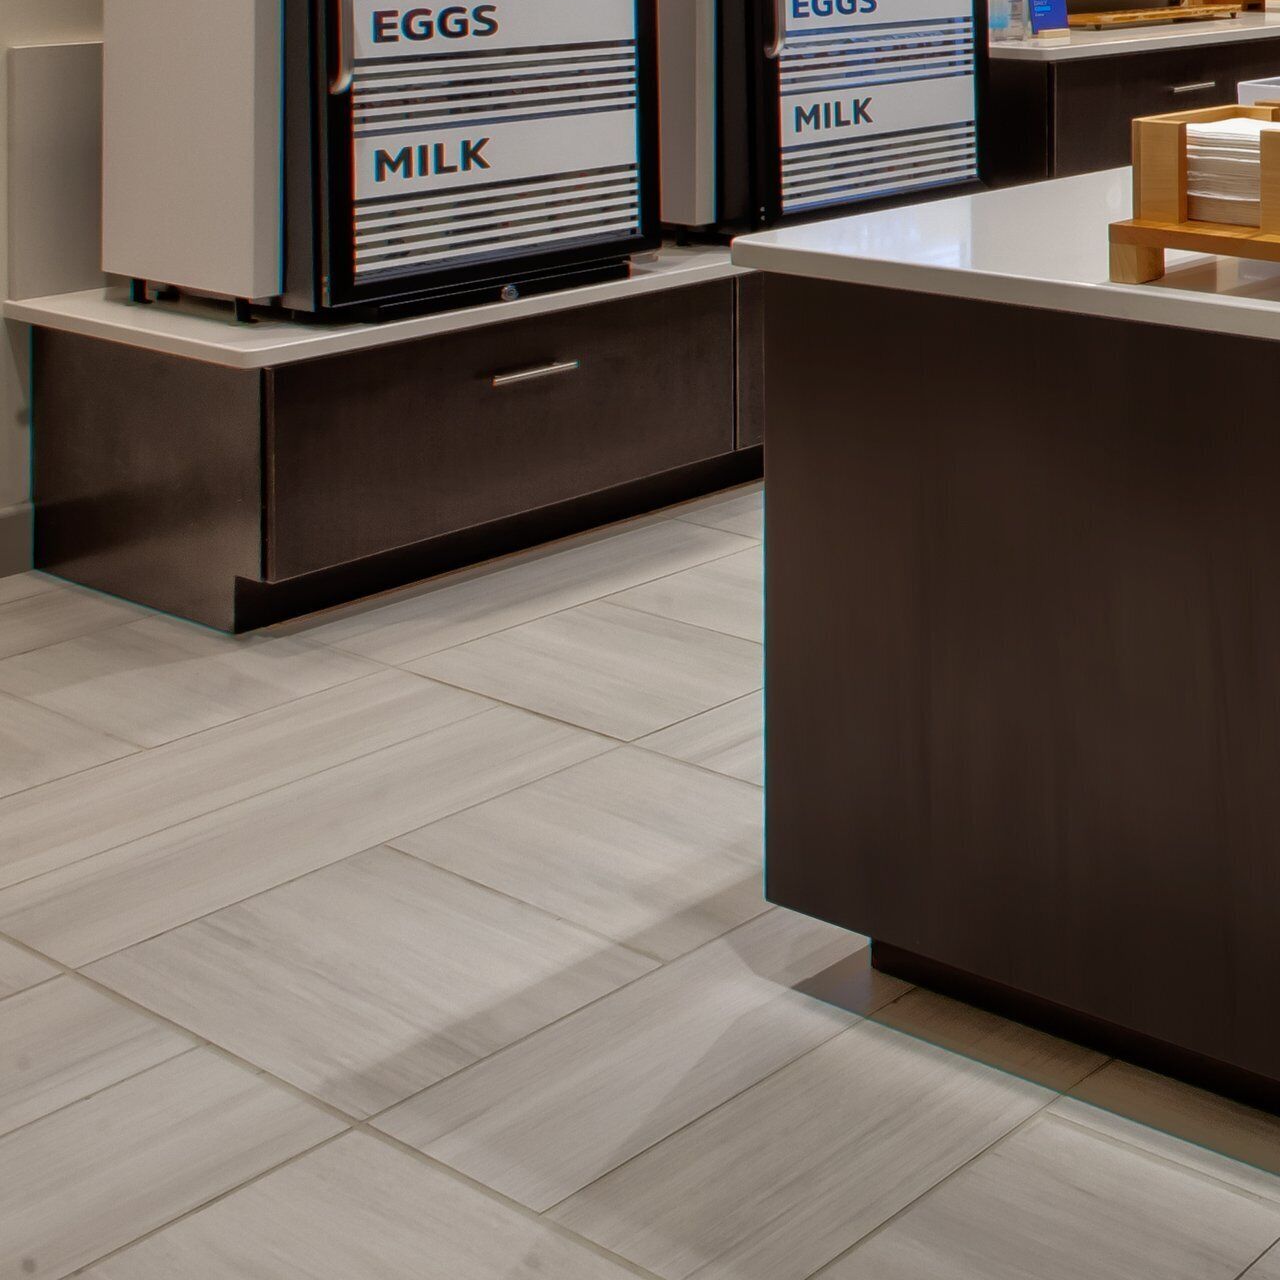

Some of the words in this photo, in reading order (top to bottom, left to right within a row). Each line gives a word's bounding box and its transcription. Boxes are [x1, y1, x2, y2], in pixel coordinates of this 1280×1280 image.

[372, 4, 500, 44] EGGS
[794, 96, 874, 133] MILK
[374, 138, 492, 183] MILK
